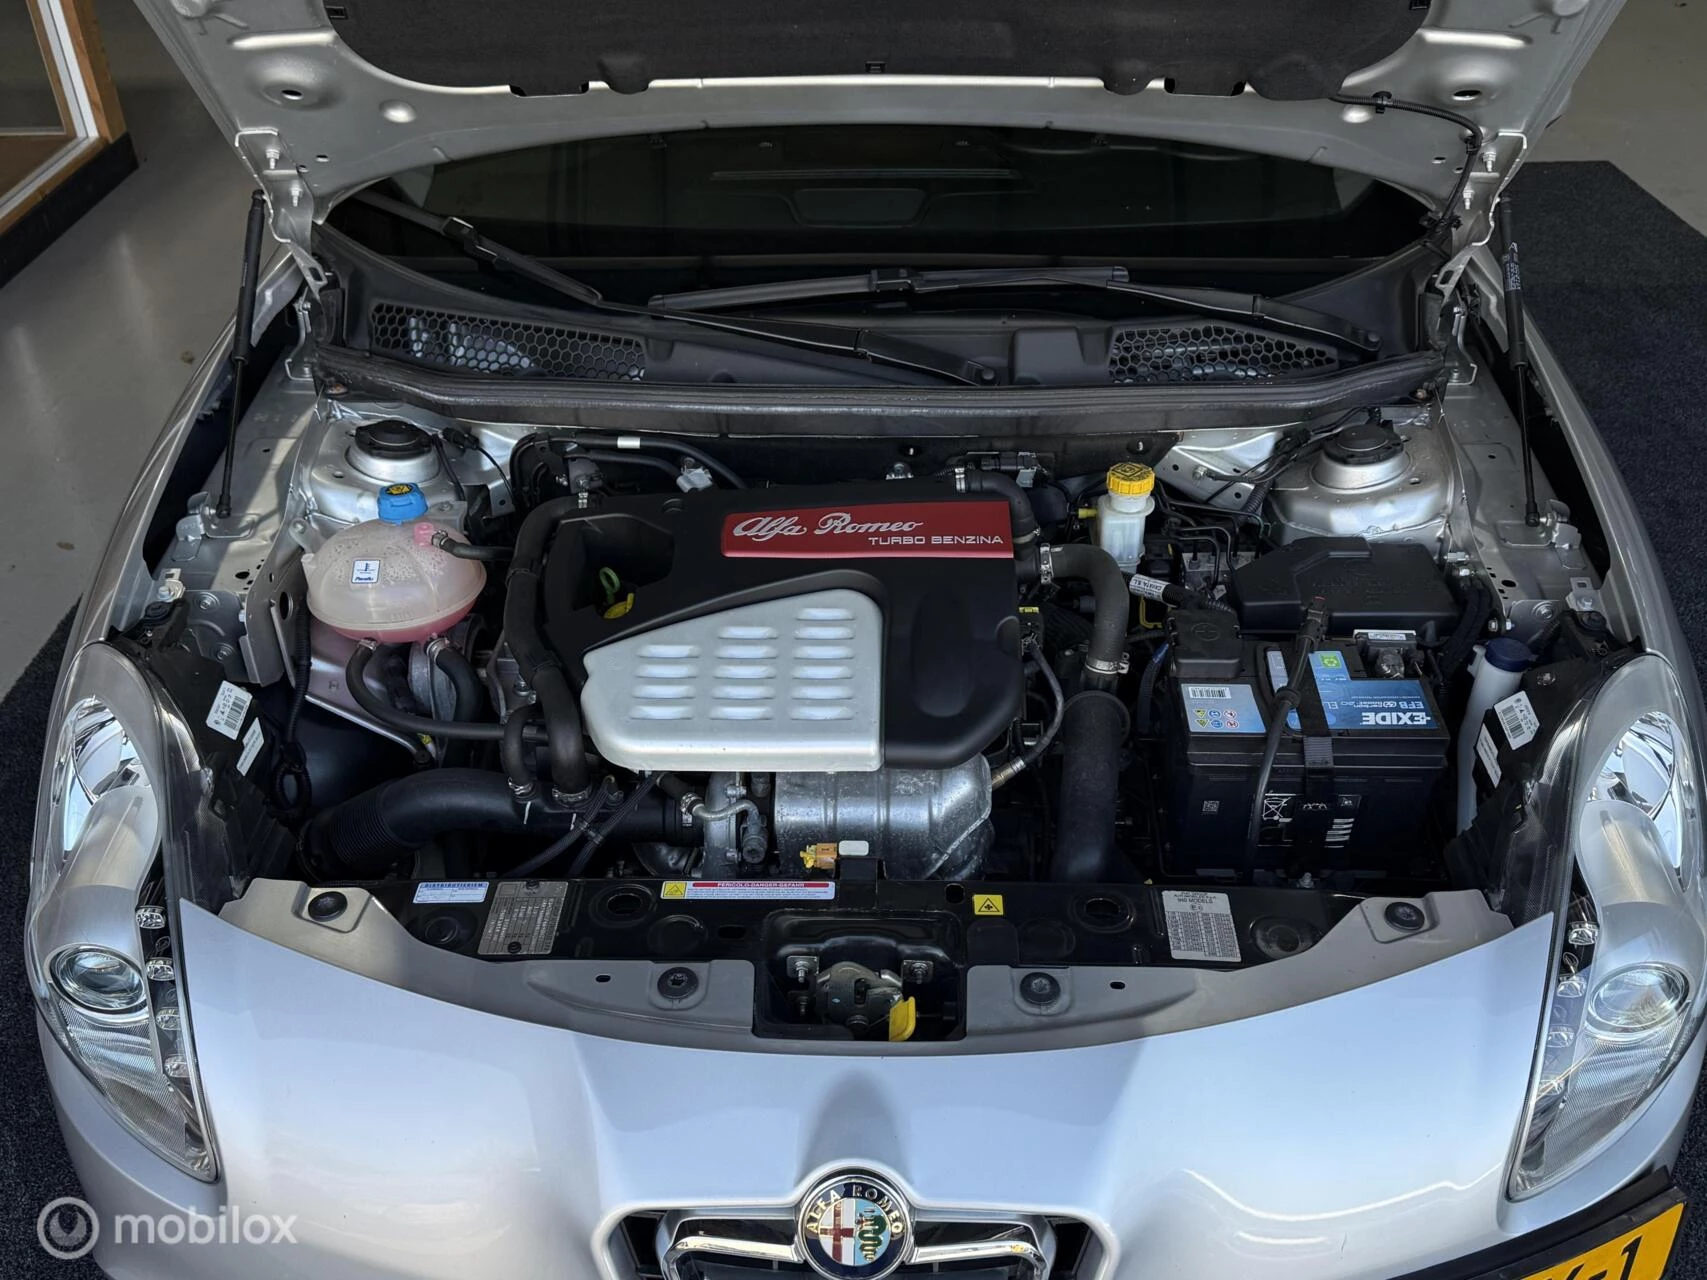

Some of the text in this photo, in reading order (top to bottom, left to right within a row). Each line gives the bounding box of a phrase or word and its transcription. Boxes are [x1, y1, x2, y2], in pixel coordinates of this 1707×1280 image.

[733, 512, 923, 541] Alfa Romeo
[868, 535, 1003, 545] TURBO BENZINA
[1399, 700, 1423, 709] EFB
[1362, 711, 1427, 725] EXIDE
[806, 1184, 904, 1234] ALFA ROMEO
